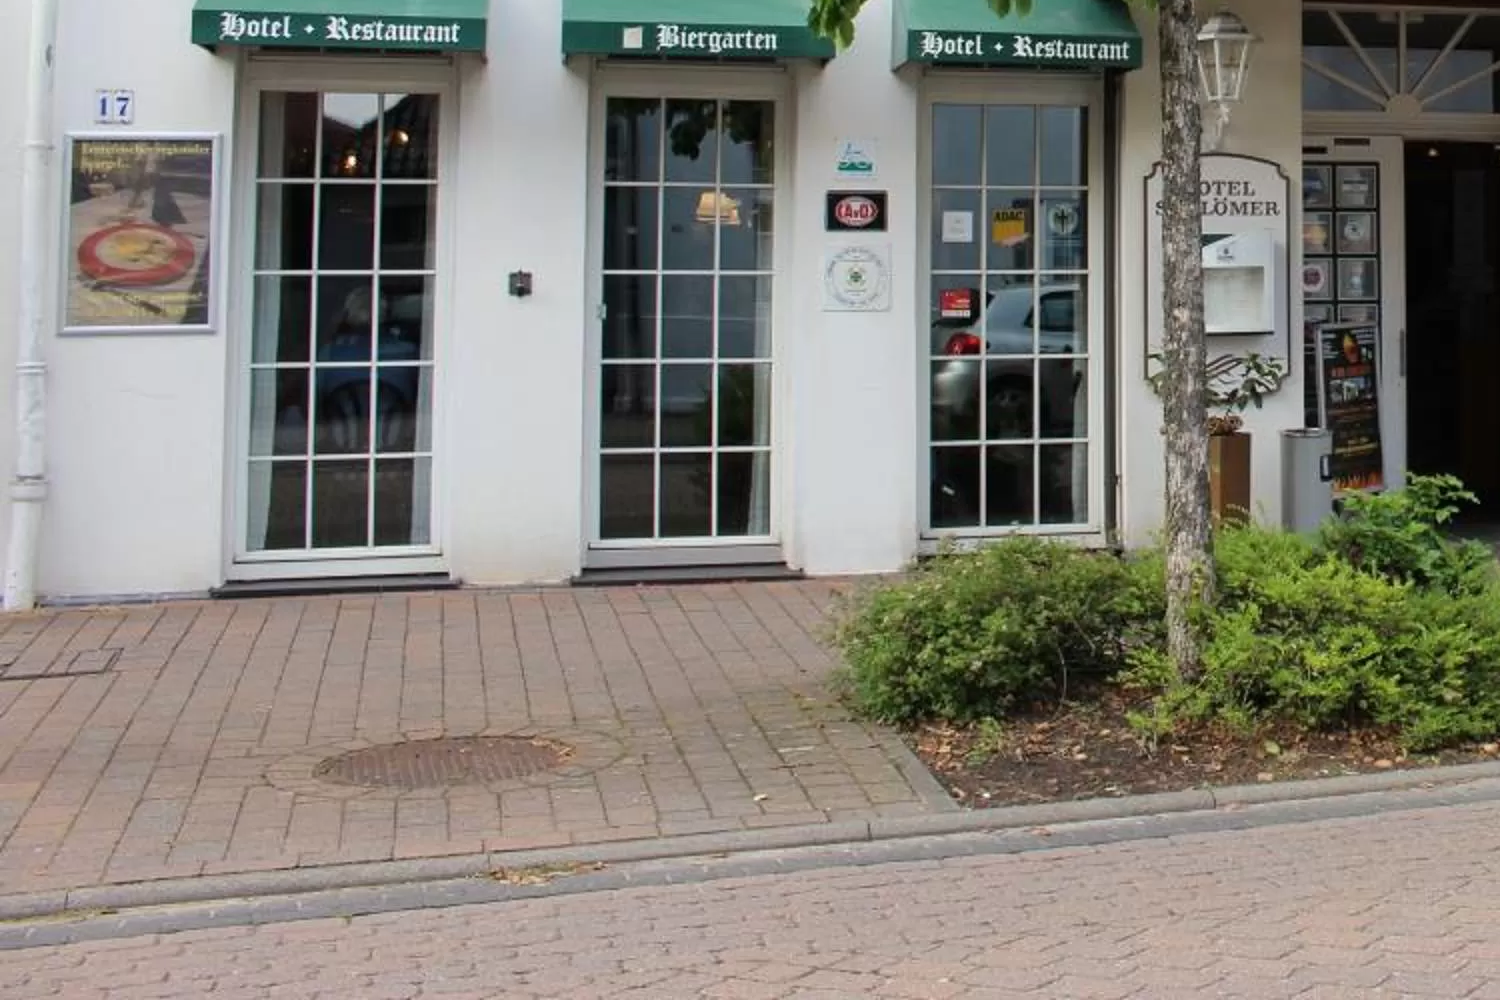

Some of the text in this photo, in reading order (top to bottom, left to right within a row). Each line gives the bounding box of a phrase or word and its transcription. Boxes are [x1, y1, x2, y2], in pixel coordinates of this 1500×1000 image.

[219, 11, 461, 43] Hotel Restaurant
[656, 23, 778, 53] Biergarten
[920, 31, 1130, 61] Hotel Restaurant
[99, 96, 130, 117] 17
[1199, 180, 1256, 197] OTEL
[1155, 198, 1281, 217] SLÖMER
